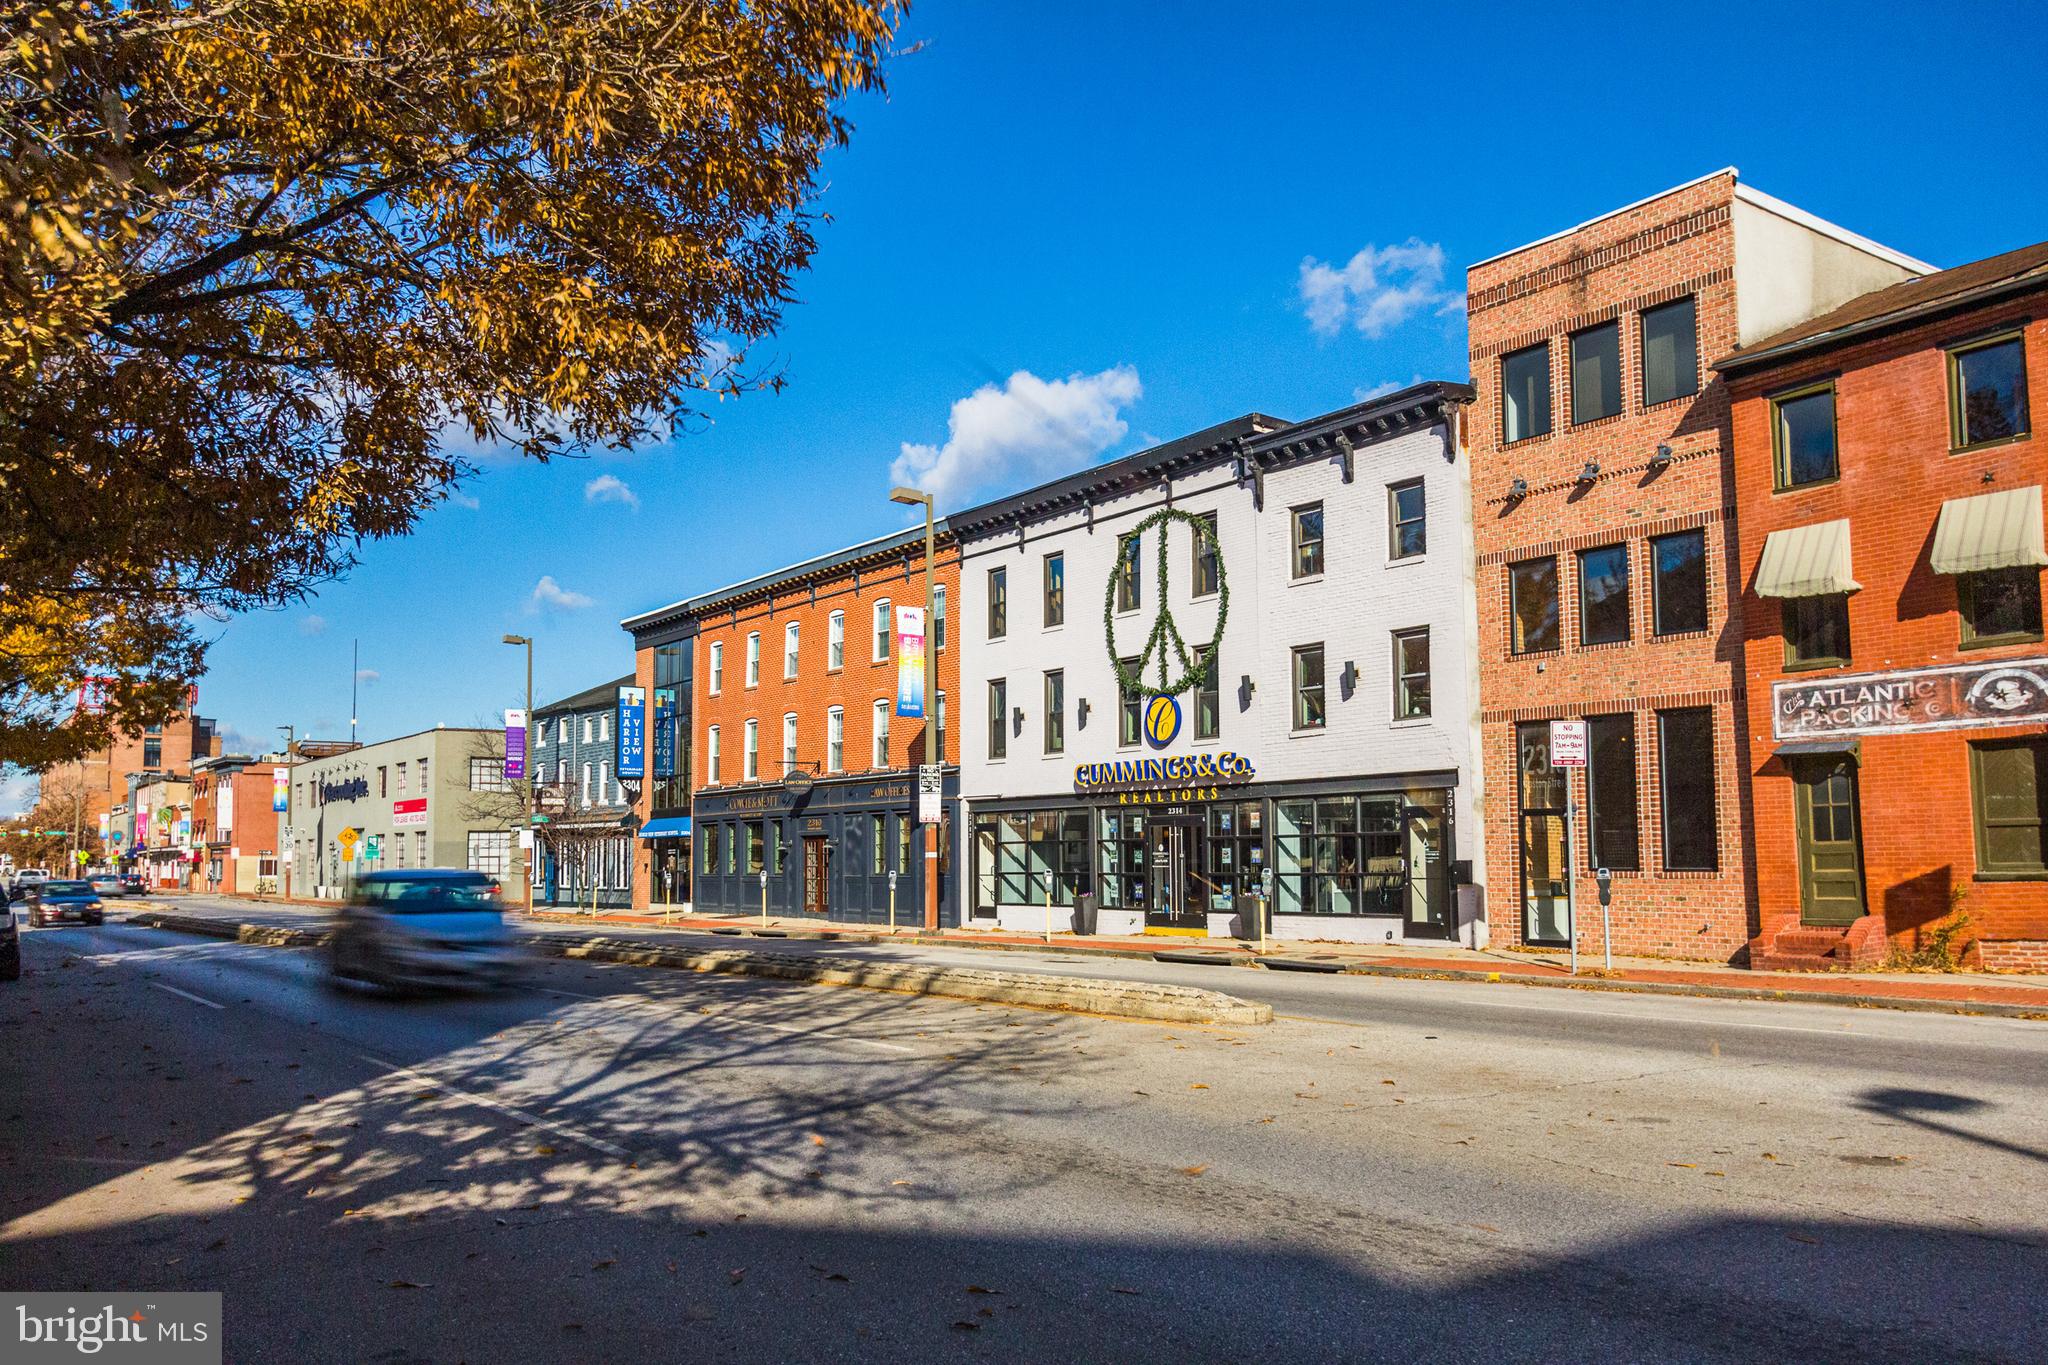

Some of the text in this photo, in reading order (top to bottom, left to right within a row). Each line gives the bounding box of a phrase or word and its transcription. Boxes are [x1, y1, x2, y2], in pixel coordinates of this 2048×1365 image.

[1808, 680, 1936, 708] ATLANTIC
[1562, 724, 1573, 732] NO
[1799, 701, 1909, 728] PACKING
[622, 709, 631, 765] HARBOR
[632, 718, 642, 755] VIEW
[1554, 733, 1583, 741] STOPPING
[1554, 741, 1583, 749] 7AM-9AM
[1119, 787, 1218, 804] REALTORS
[1447, 789, 1455, 825] 2316
